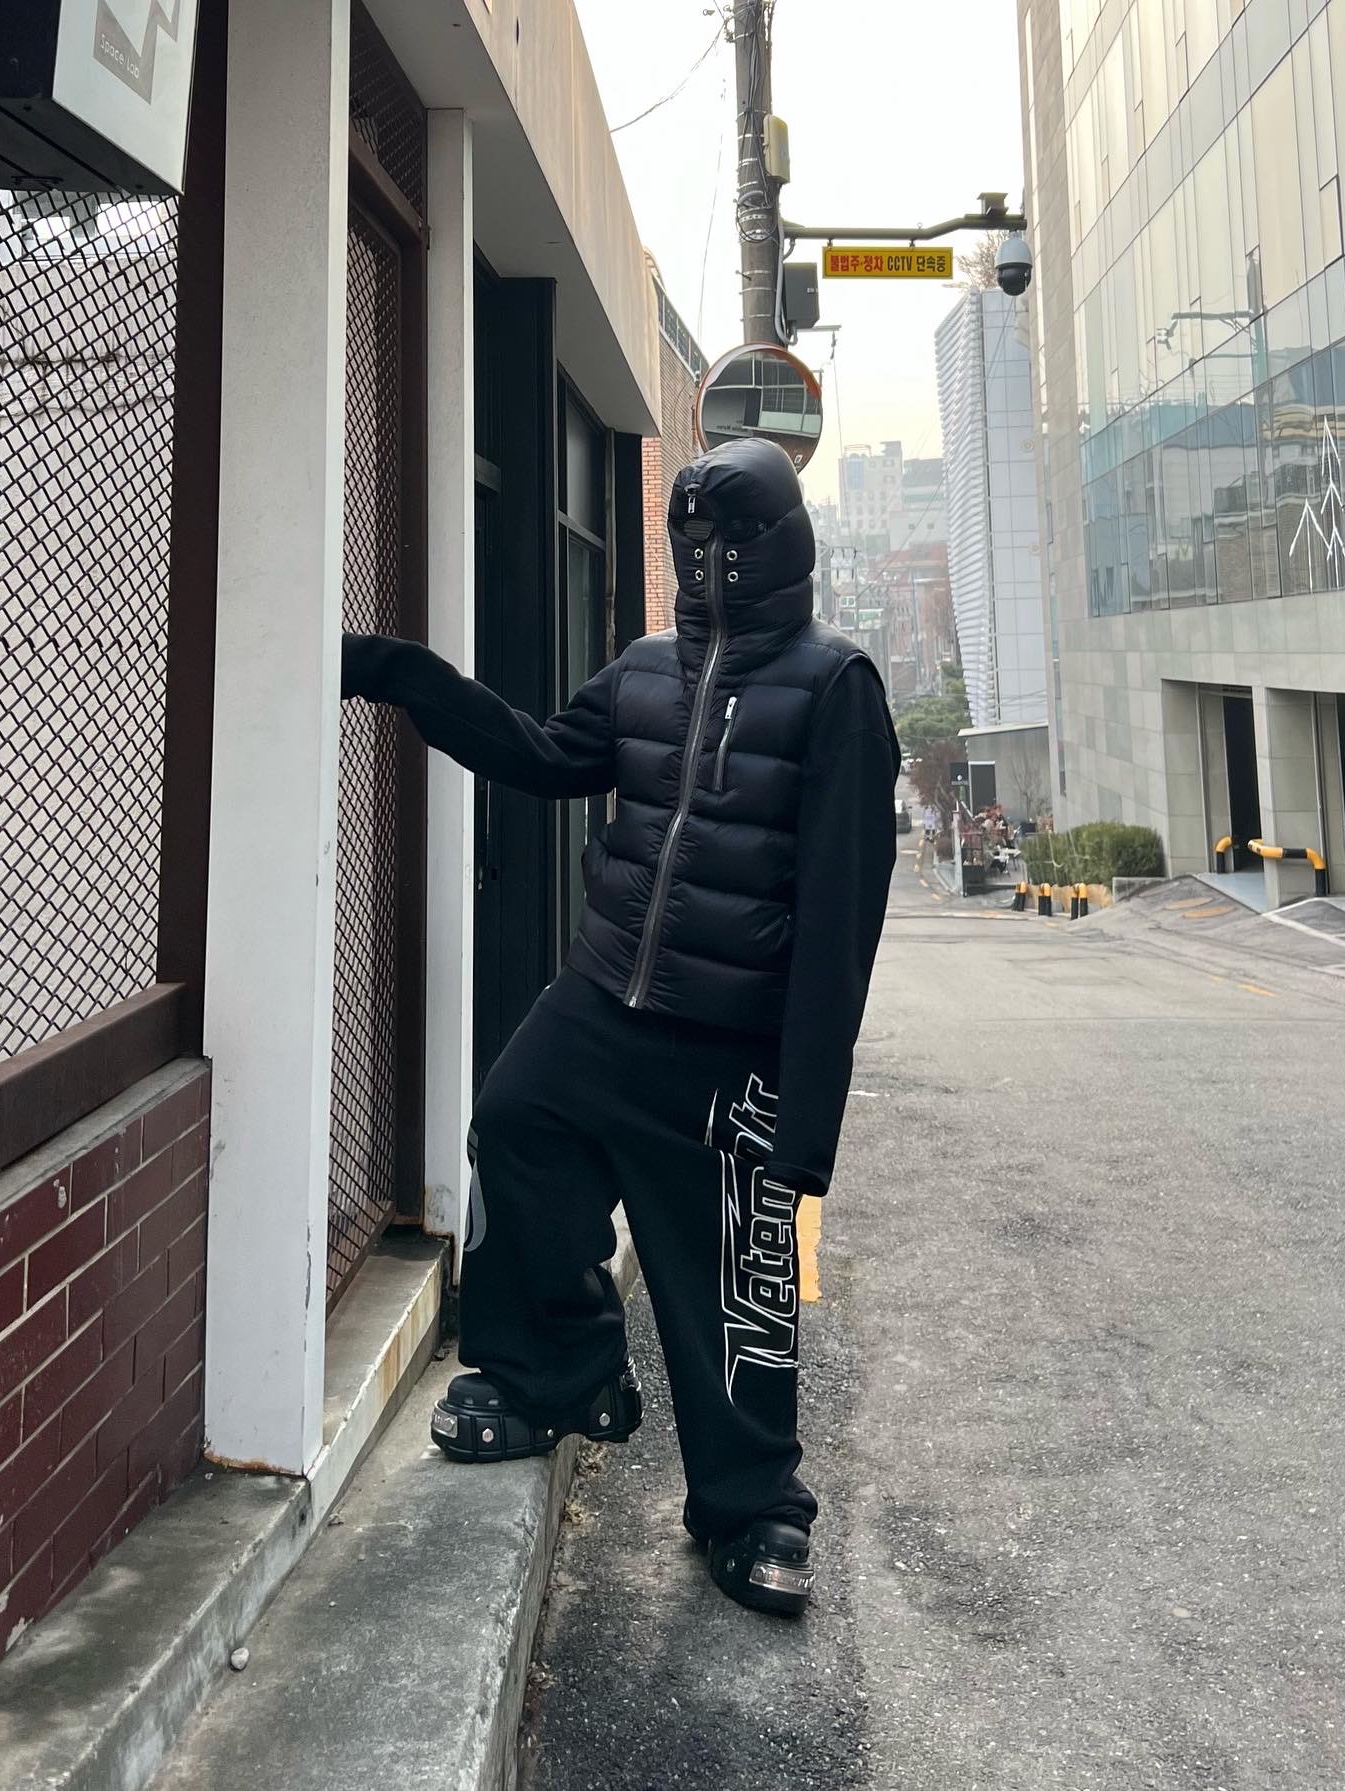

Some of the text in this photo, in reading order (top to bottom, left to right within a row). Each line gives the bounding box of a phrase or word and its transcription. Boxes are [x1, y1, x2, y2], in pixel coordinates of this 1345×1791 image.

[100, 33, 124, 65] Space
[887, 255, 912, 272] CCTV
[916, 255, 945, 272] 단속중
